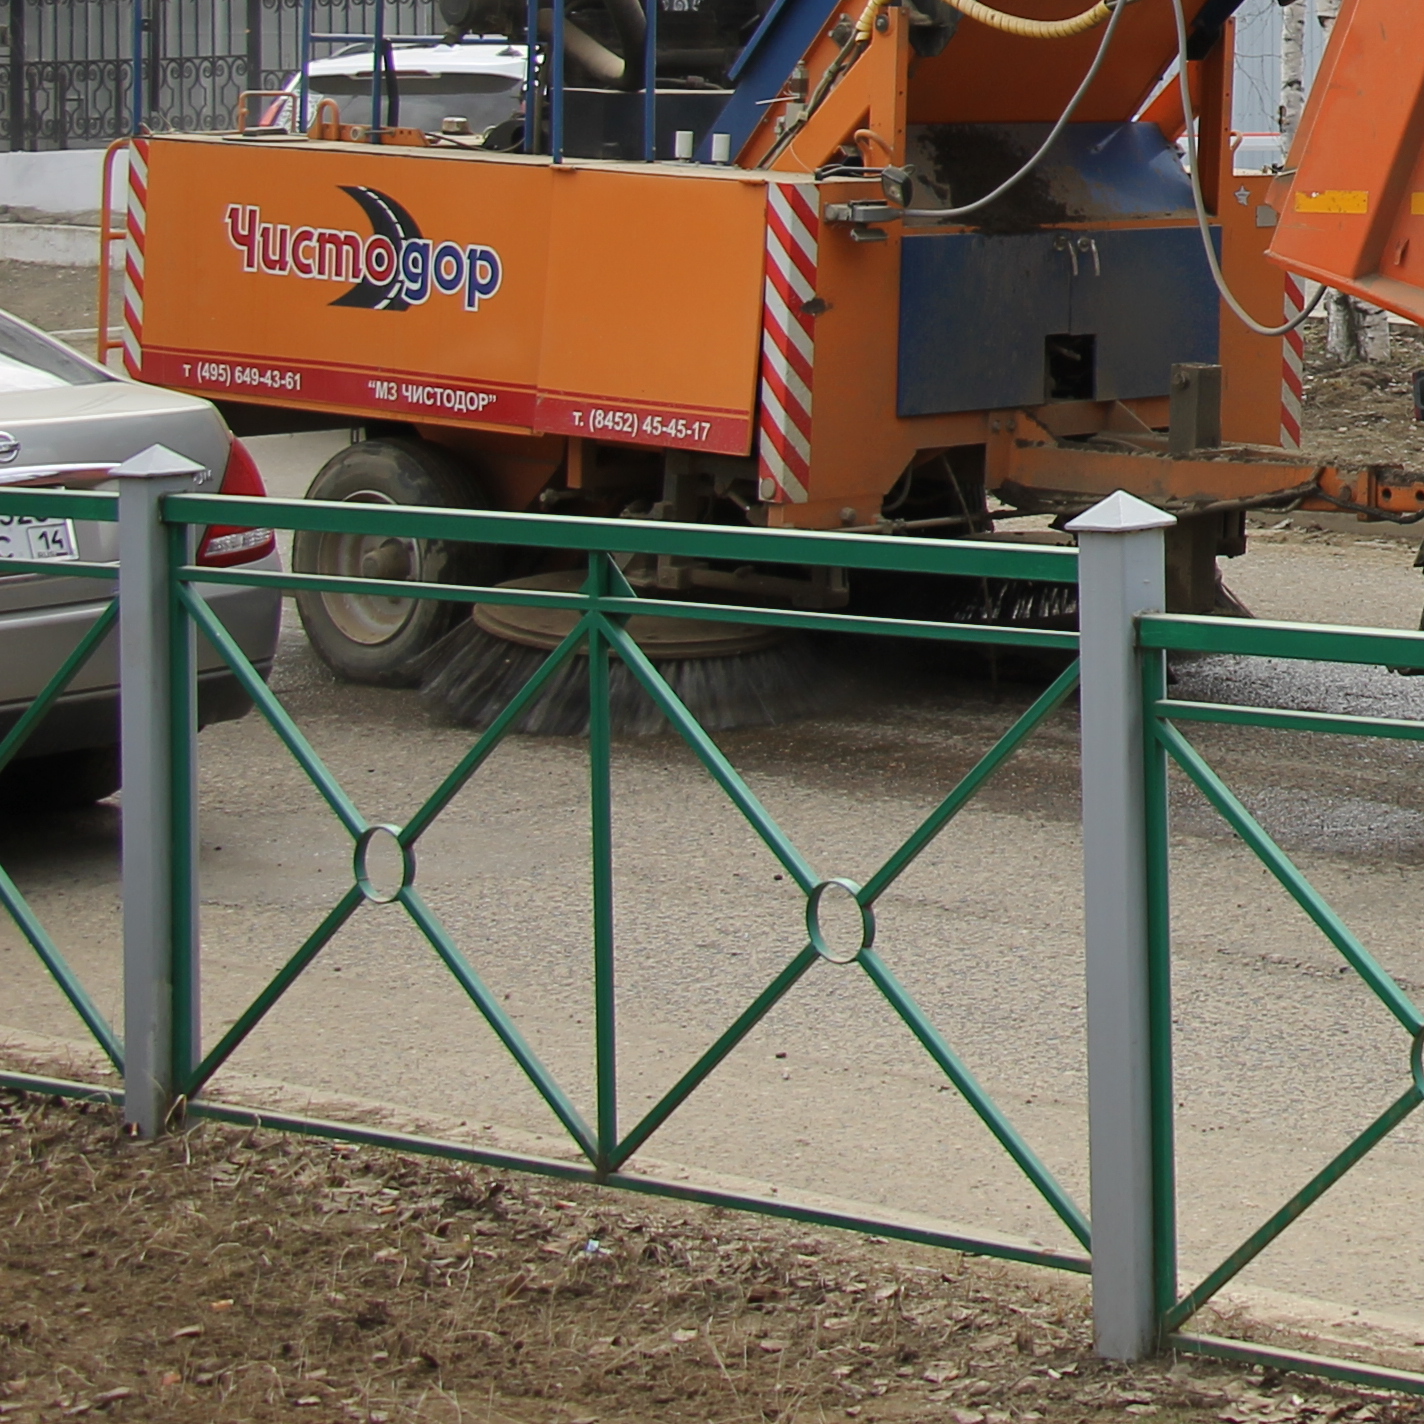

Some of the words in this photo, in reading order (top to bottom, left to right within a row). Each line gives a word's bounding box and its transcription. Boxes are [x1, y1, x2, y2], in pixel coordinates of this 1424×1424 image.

[225, 203, 502, 312] Чистодор
[197, 360, 231, 387] (495)
[234, 365, 302, 391] 649-43-61
[588, 408, 639, 438] (8452)
[642, 414, 712, 442] 45-45-17
[38, 529, 64, 550] 14
